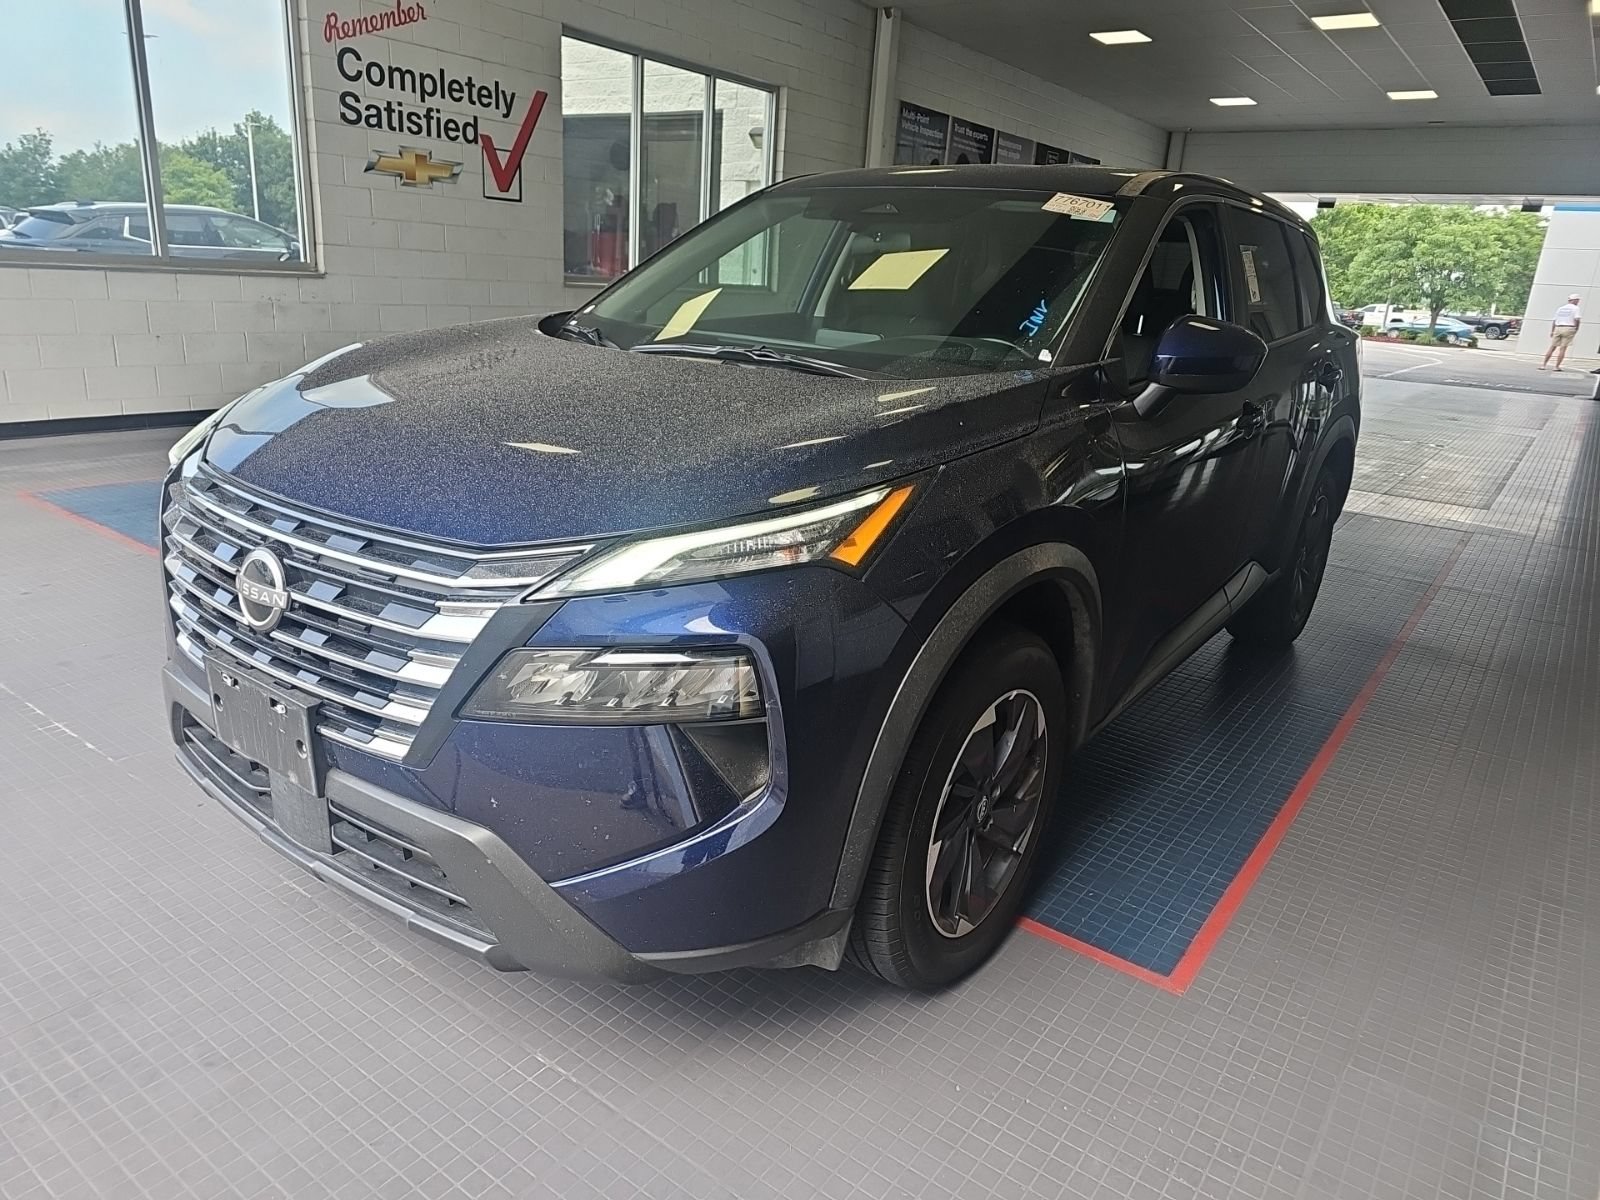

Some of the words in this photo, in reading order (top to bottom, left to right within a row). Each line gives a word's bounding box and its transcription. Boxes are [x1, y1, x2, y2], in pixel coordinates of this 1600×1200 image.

[324, 0, 428, 43] Remember
[337, 46, 516, 118] Completely
[339, 91, 479, 145] Satisfied
[901, 118, 919, 133] Vehicle
[902, 107, 930, 125] Multi-Point
